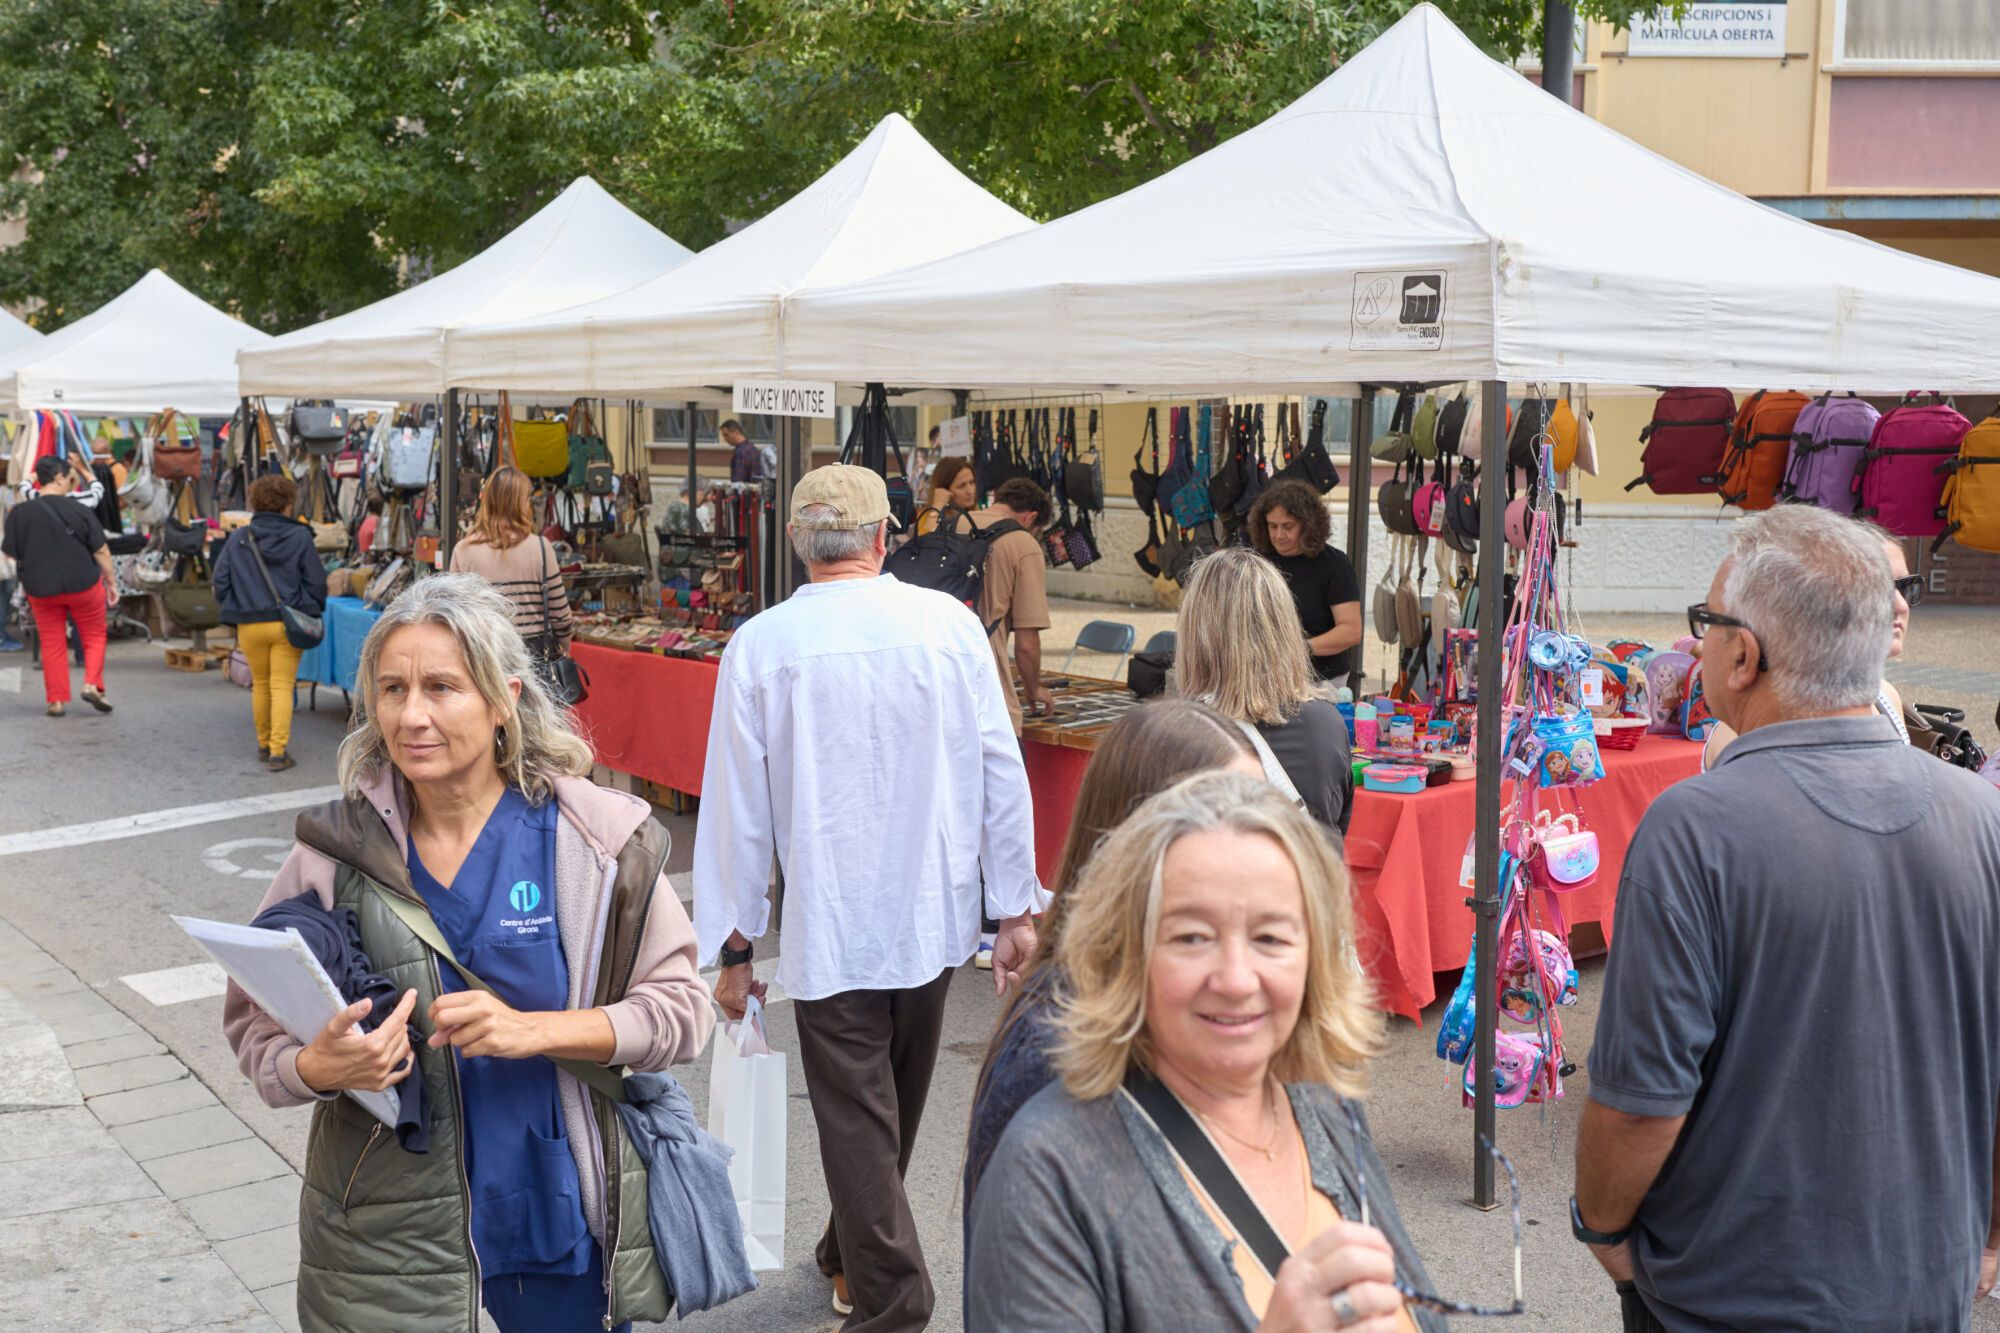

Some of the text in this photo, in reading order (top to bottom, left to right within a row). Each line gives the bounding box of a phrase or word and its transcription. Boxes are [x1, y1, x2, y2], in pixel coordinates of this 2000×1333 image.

[1722, 29, 1774, 40] OBERTA
[1419, 326, 1440, 338] ENDURO
[743, 387, 825, 413] MICKEY MONTSE
